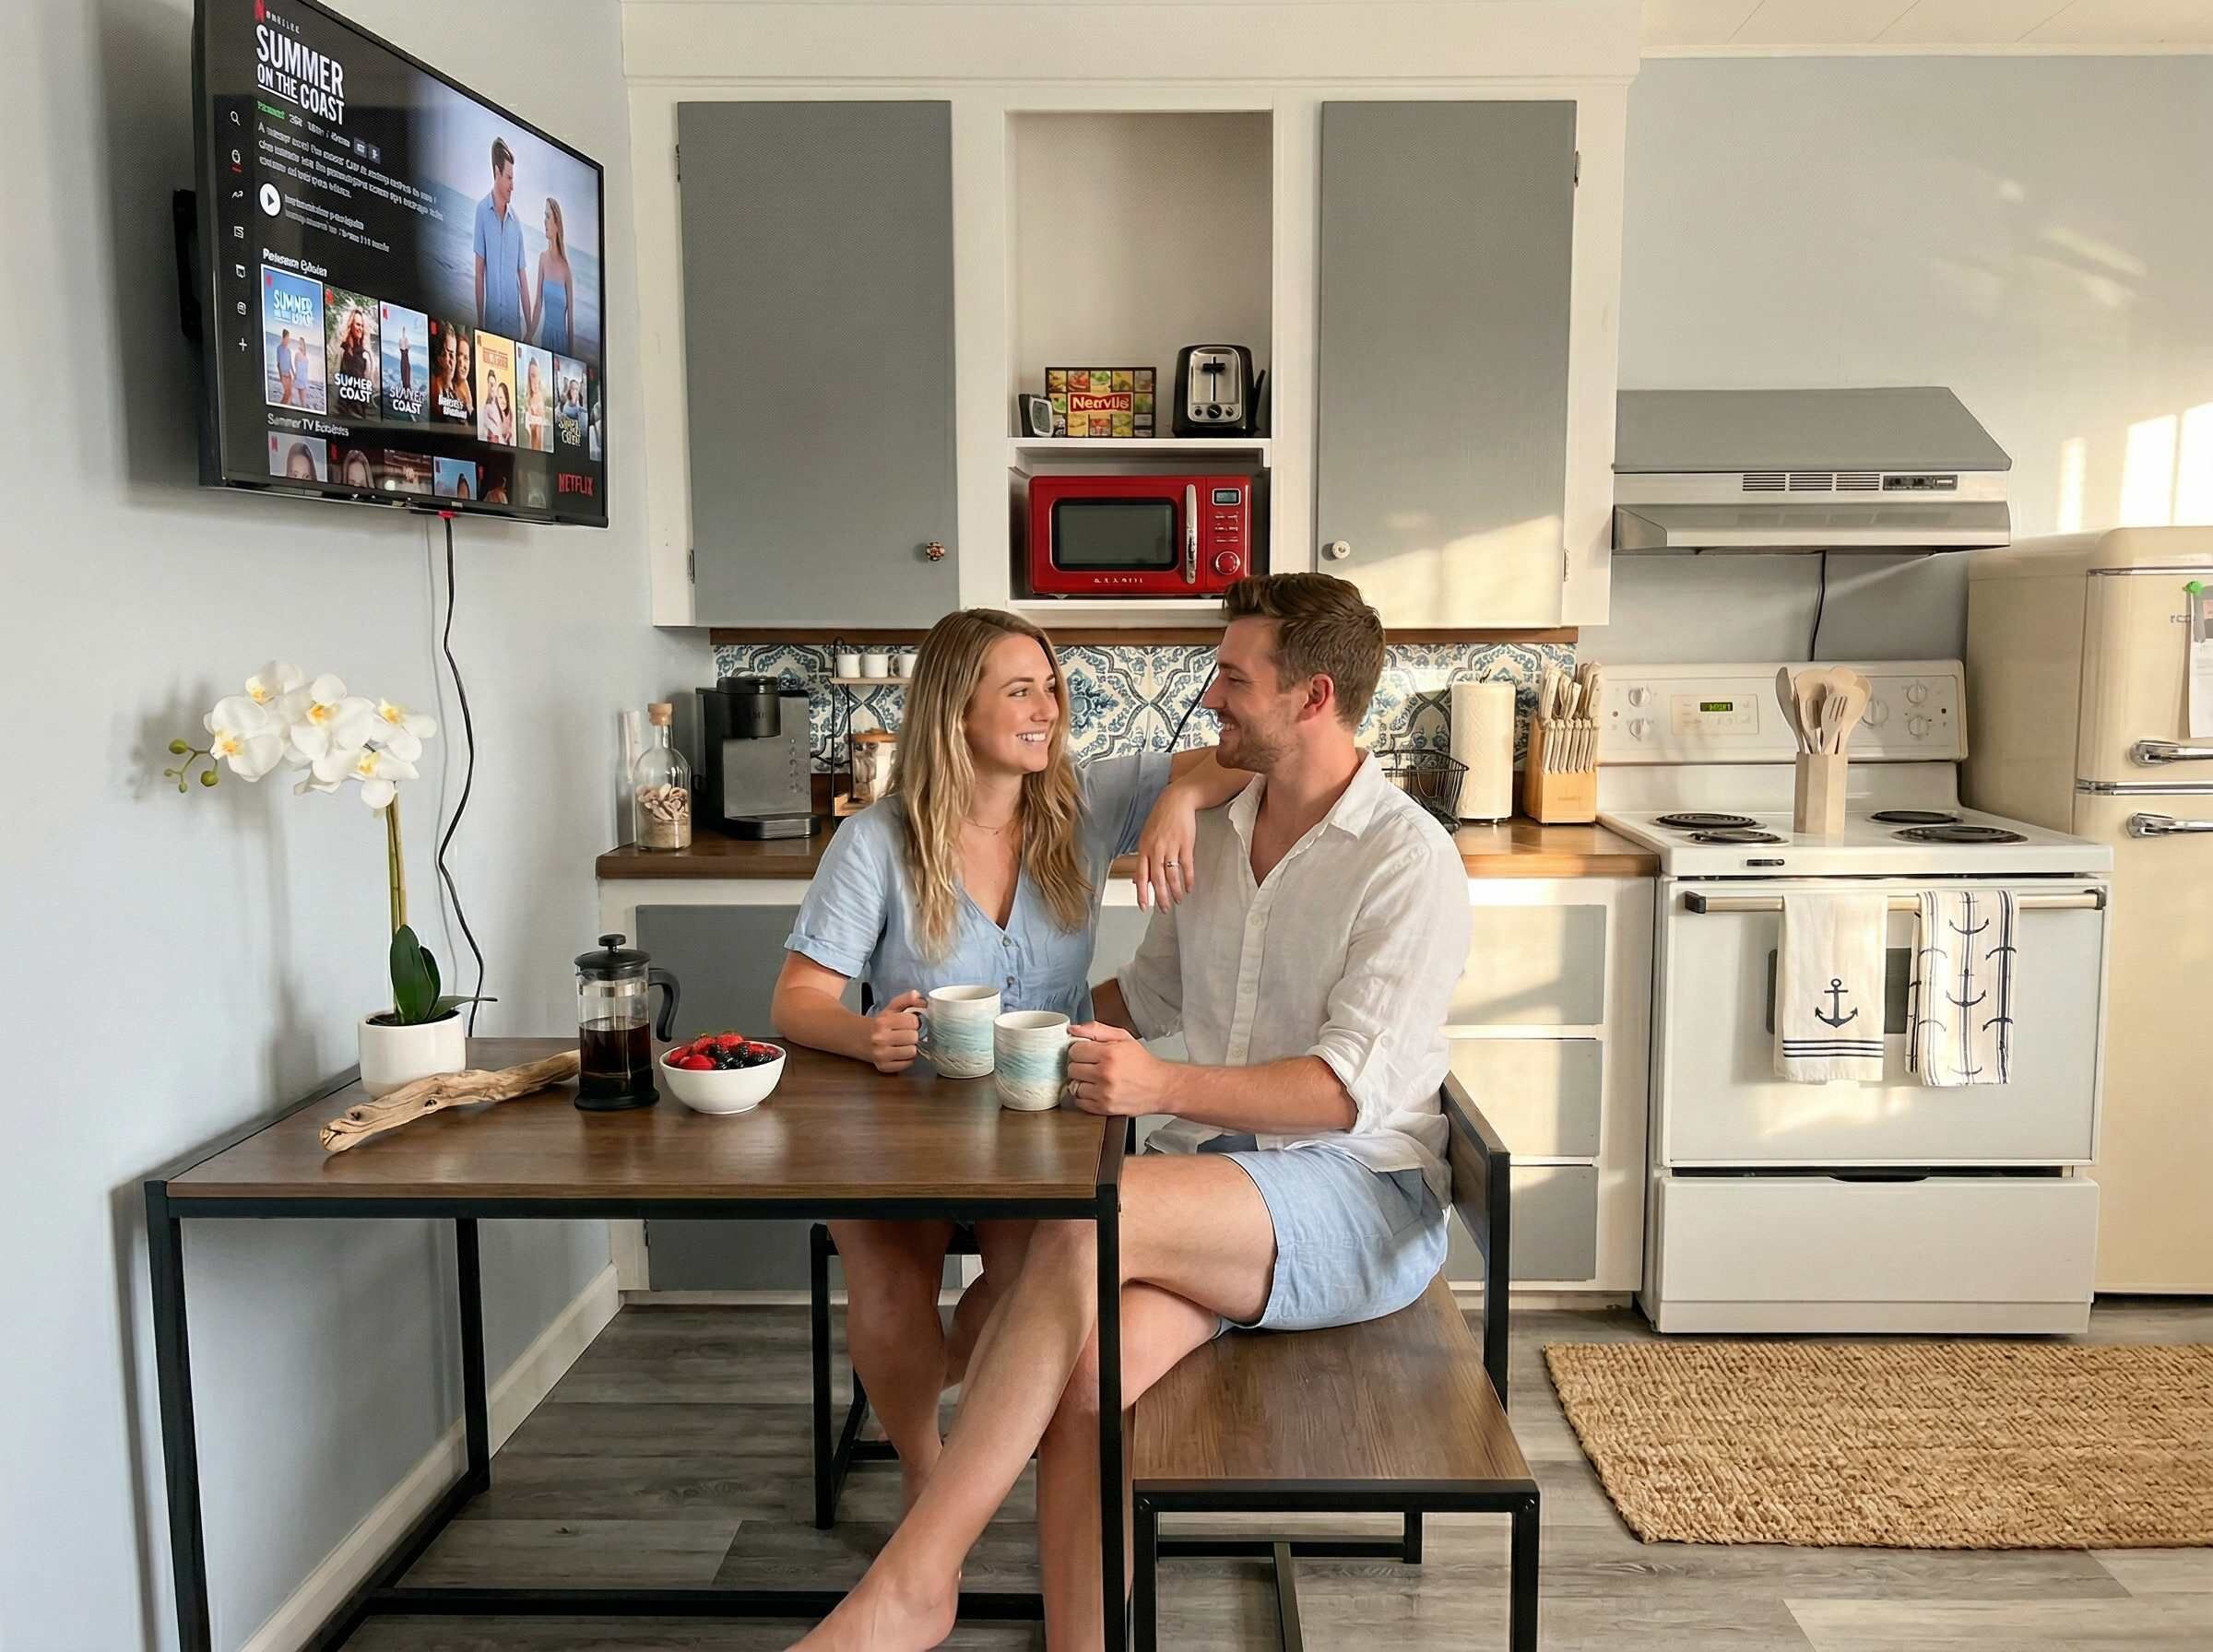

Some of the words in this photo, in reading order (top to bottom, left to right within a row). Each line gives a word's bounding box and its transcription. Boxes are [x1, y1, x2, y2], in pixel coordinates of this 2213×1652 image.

[256, 24, 344, 99] SUMMER
[258, 63, 274, 88] ON
[276, 71, 298, 99] THE
[300, 83, 345, 125] COAST
[339, 386, 372, 403] COAST
[393, 398, 421, 414] COAST
[302, 418, 314, 431] TV
[559, 473, 594, 497] NETFLIX
